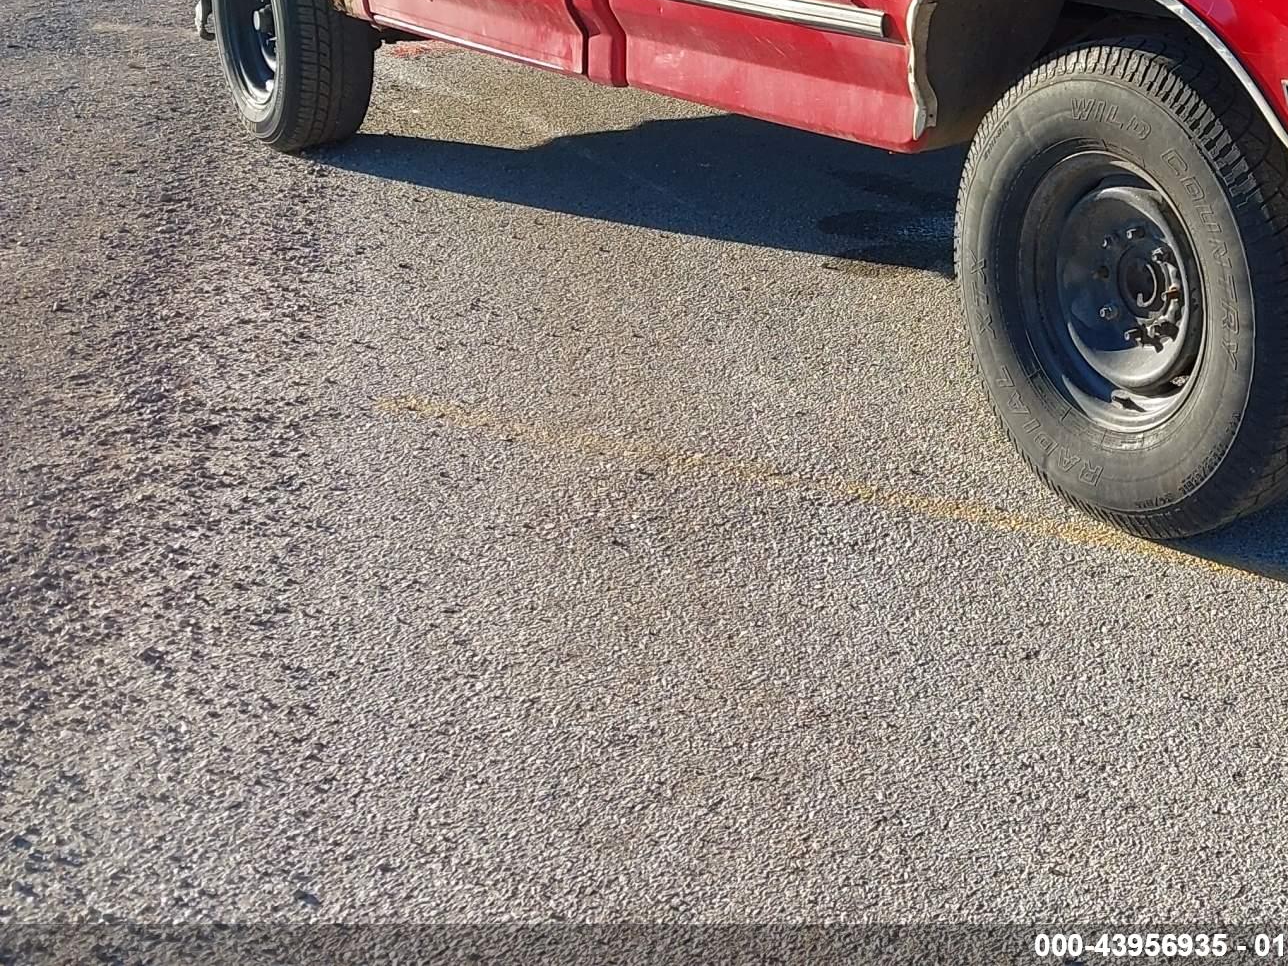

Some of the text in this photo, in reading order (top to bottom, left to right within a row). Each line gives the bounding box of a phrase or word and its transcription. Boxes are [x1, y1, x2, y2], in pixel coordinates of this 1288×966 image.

[1070, 97, 1152, 140] WILD
[1159, 148, 1240, 371] COUNTRY
[995, 364, 1105, 487] RADIAL
